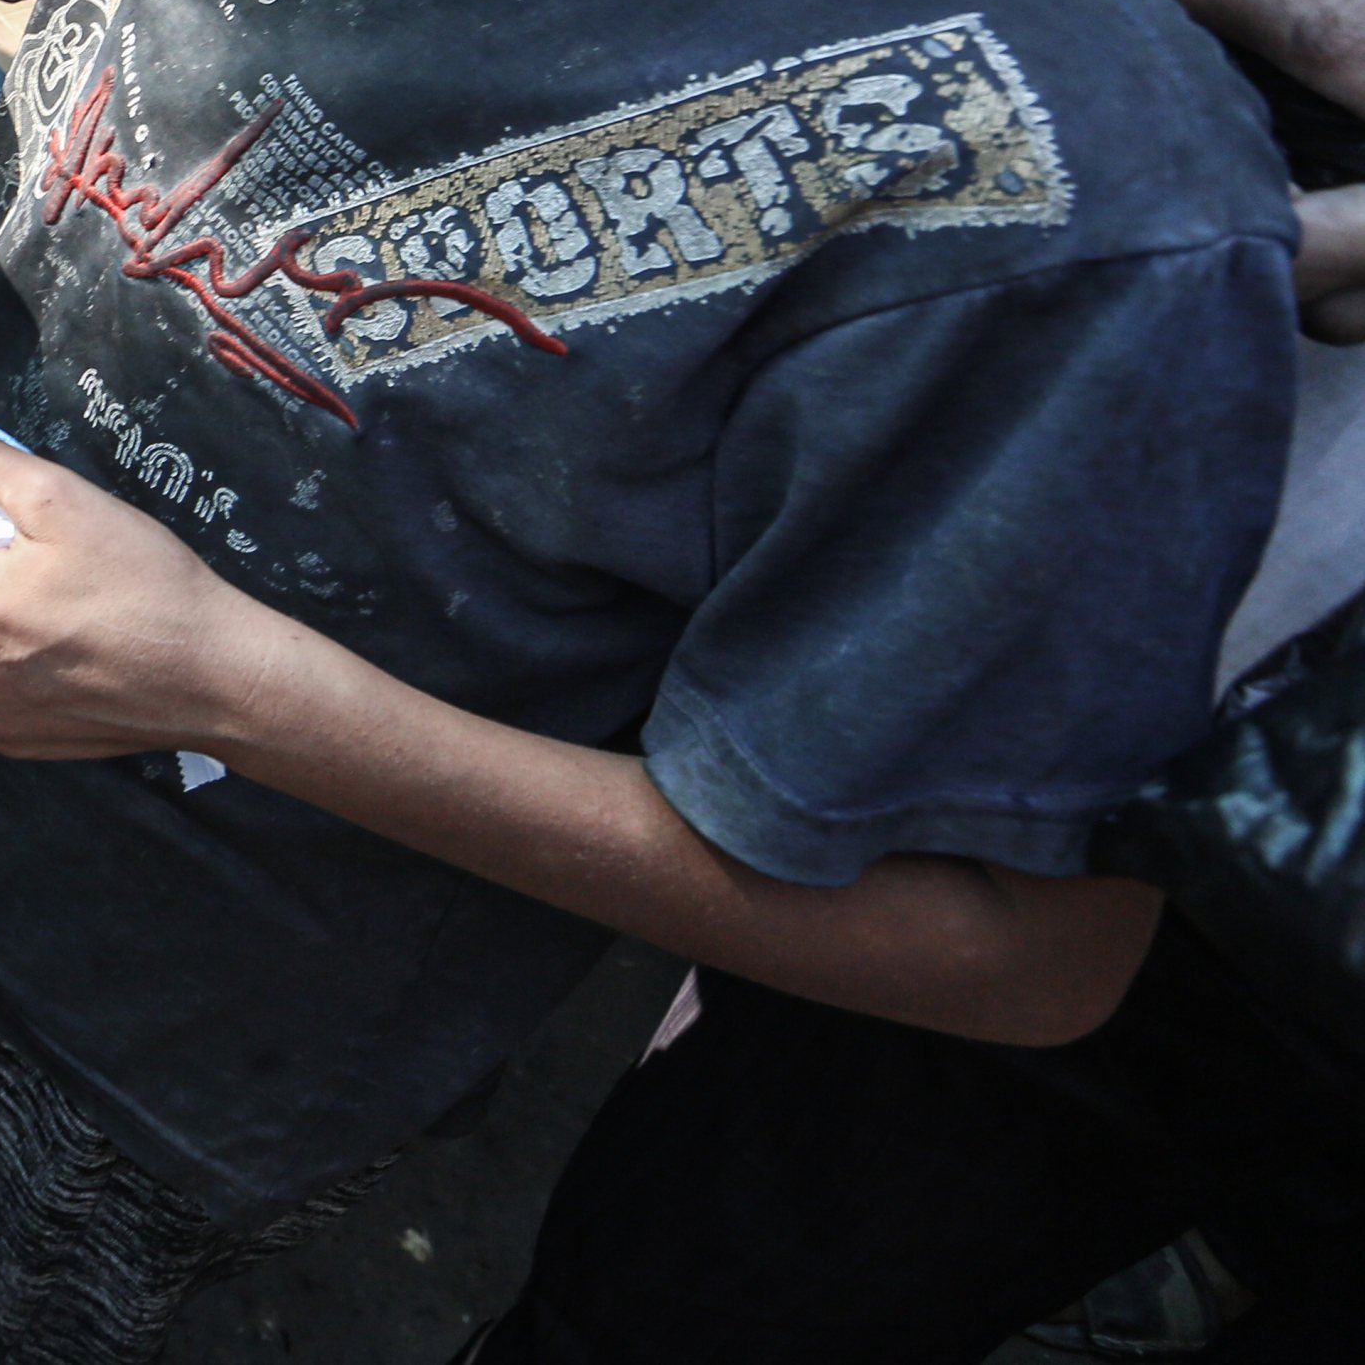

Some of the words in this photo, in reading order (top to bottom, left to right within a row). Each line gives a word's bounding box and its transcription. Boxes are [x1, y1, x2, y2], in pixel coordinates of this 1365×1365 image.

[259, 73, 354, 172] CONERVATION
[282, 73, 323, 123] TAKING
[321, 122, 367, 163] CARE
